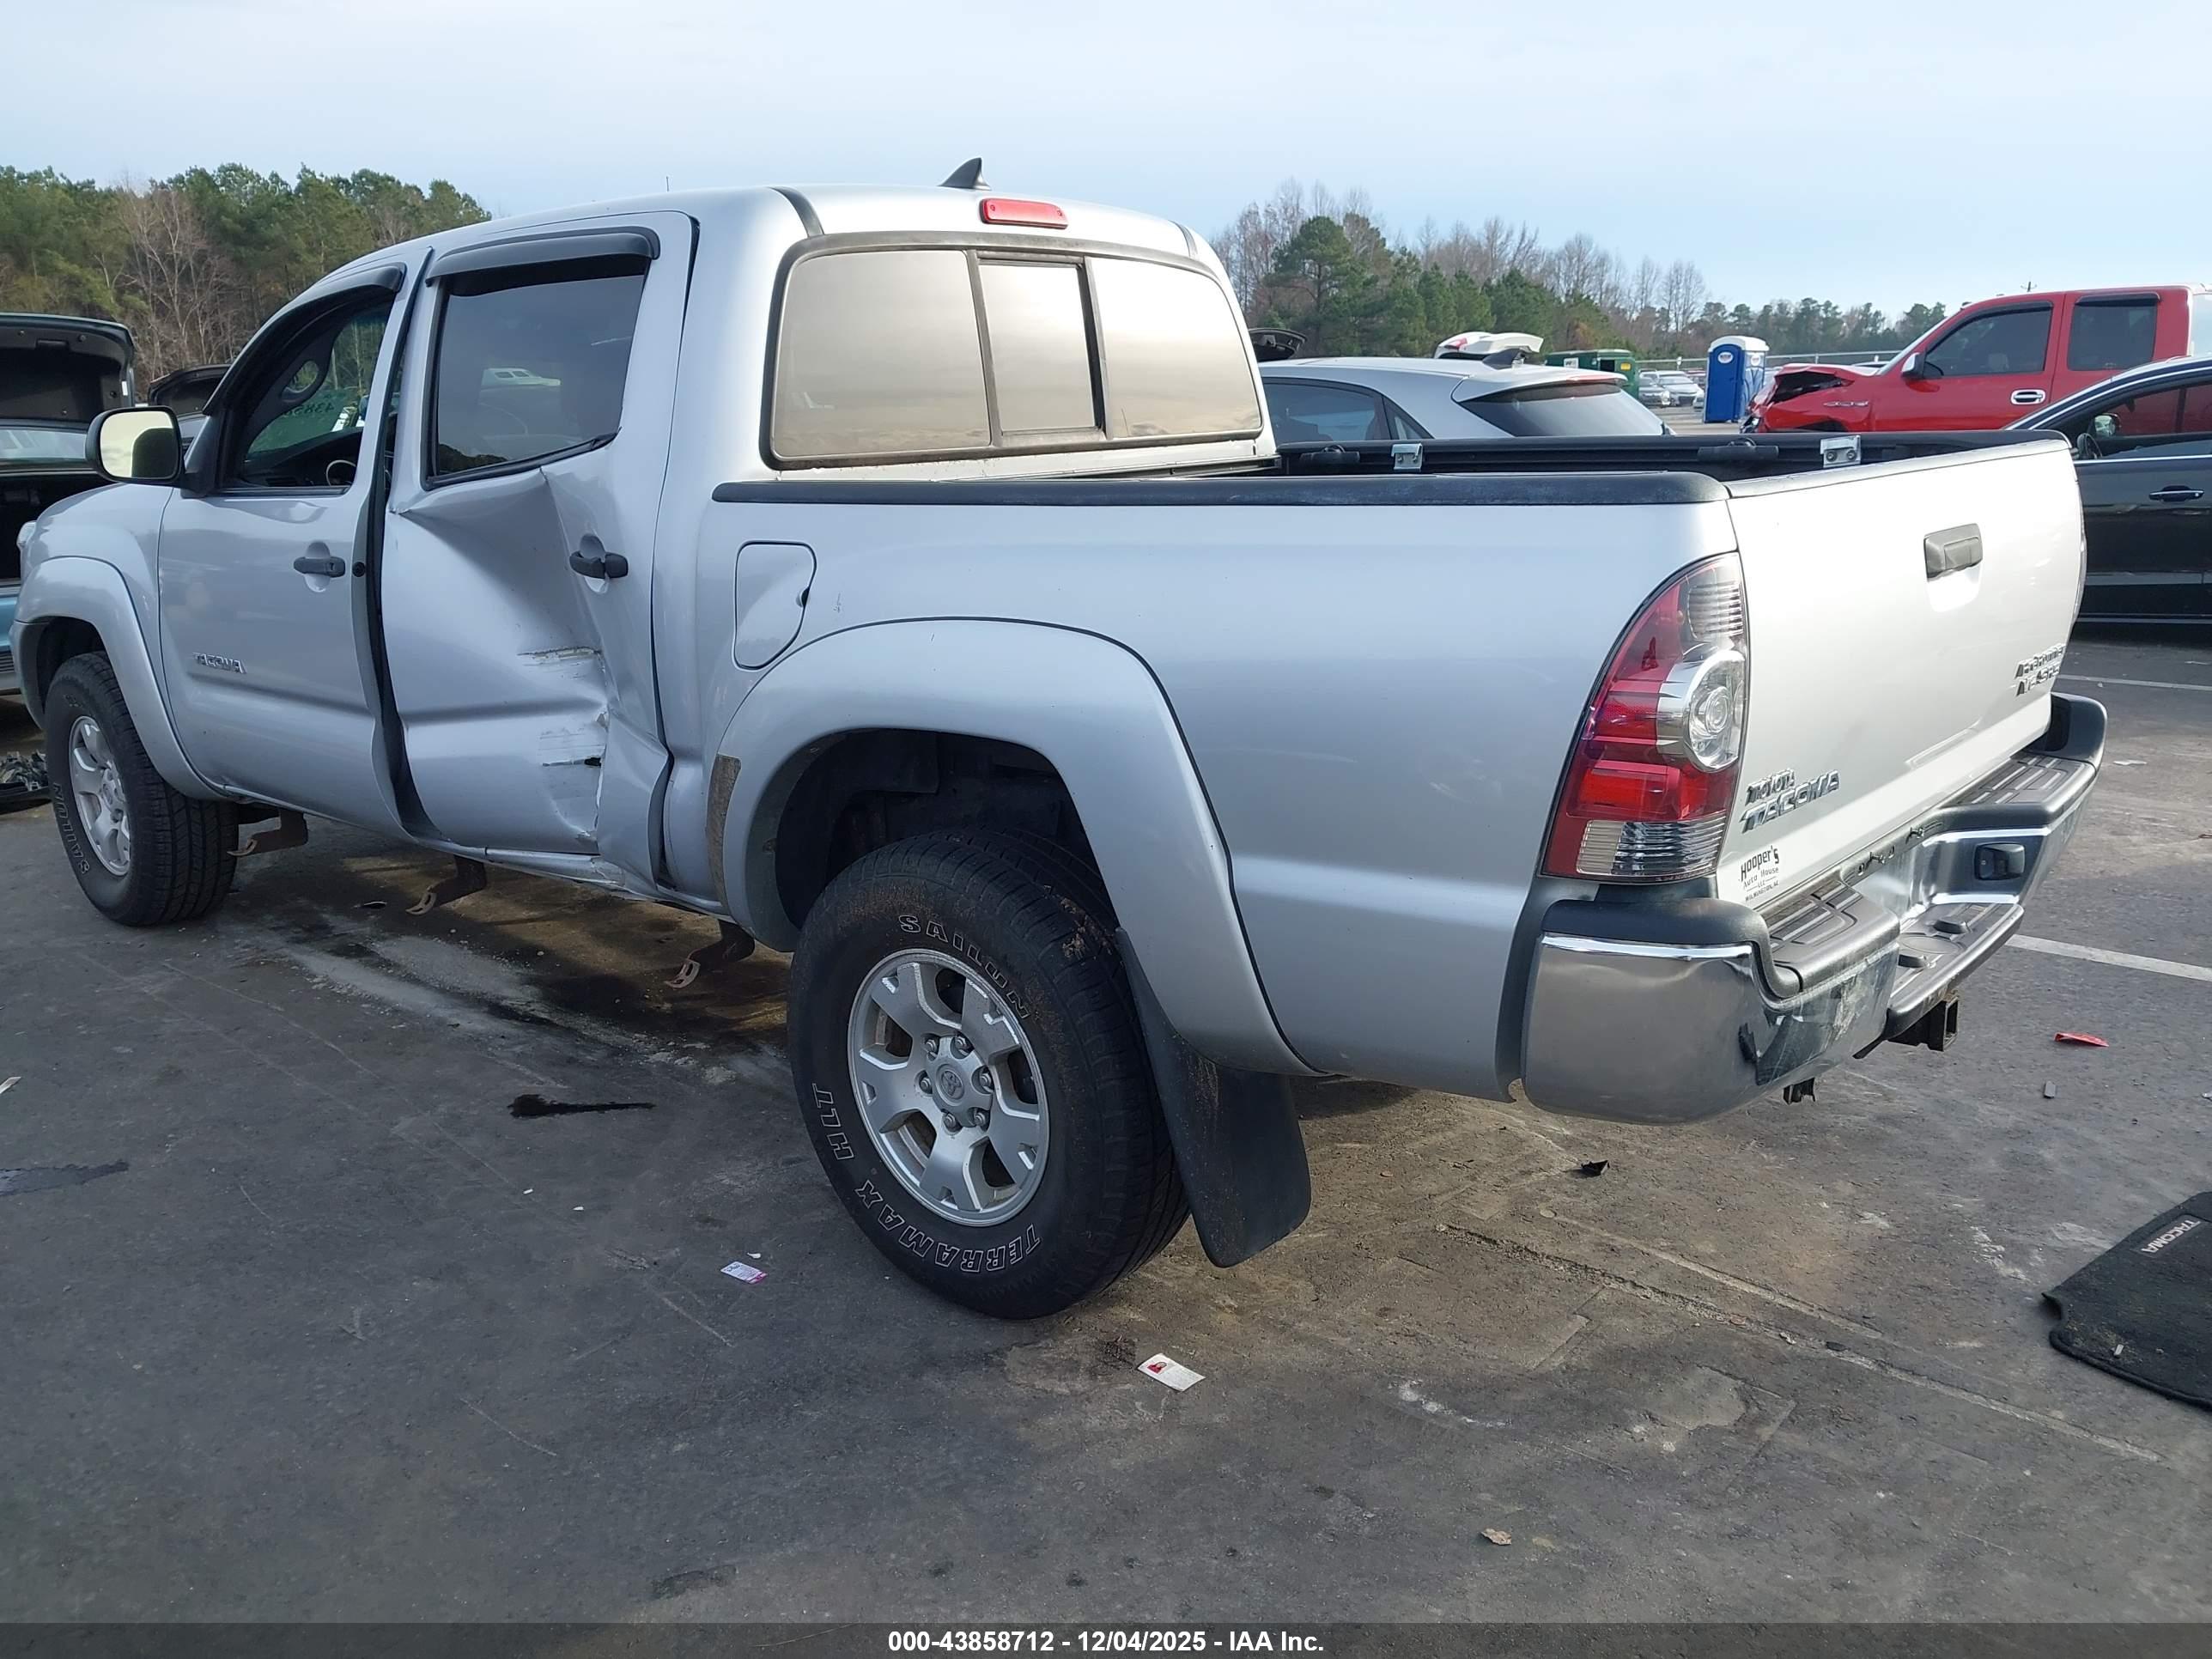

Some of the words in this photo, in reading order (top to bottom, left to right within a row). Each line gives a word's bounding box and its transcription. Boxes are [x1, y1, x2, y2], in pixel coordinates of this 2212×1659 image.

[192, 652, 247, 674] TACOMA
[1739, 769, 1839, 834] TACOMA
[1745, 769, 1796, 806] TOYOTA
[1741, 845, 1779, 882] Hooper's
[1744, 874, 1758, 889] Auto
[1760, 867, 1779, 878] House
[898, 915, 1030, 1019] SAILUN
[811, 1083, 854, 1160] HLT
[854, 1179, 1042, 1273] TERRAMAX
[2141, 1219, 2202, 1253] TACOMA
